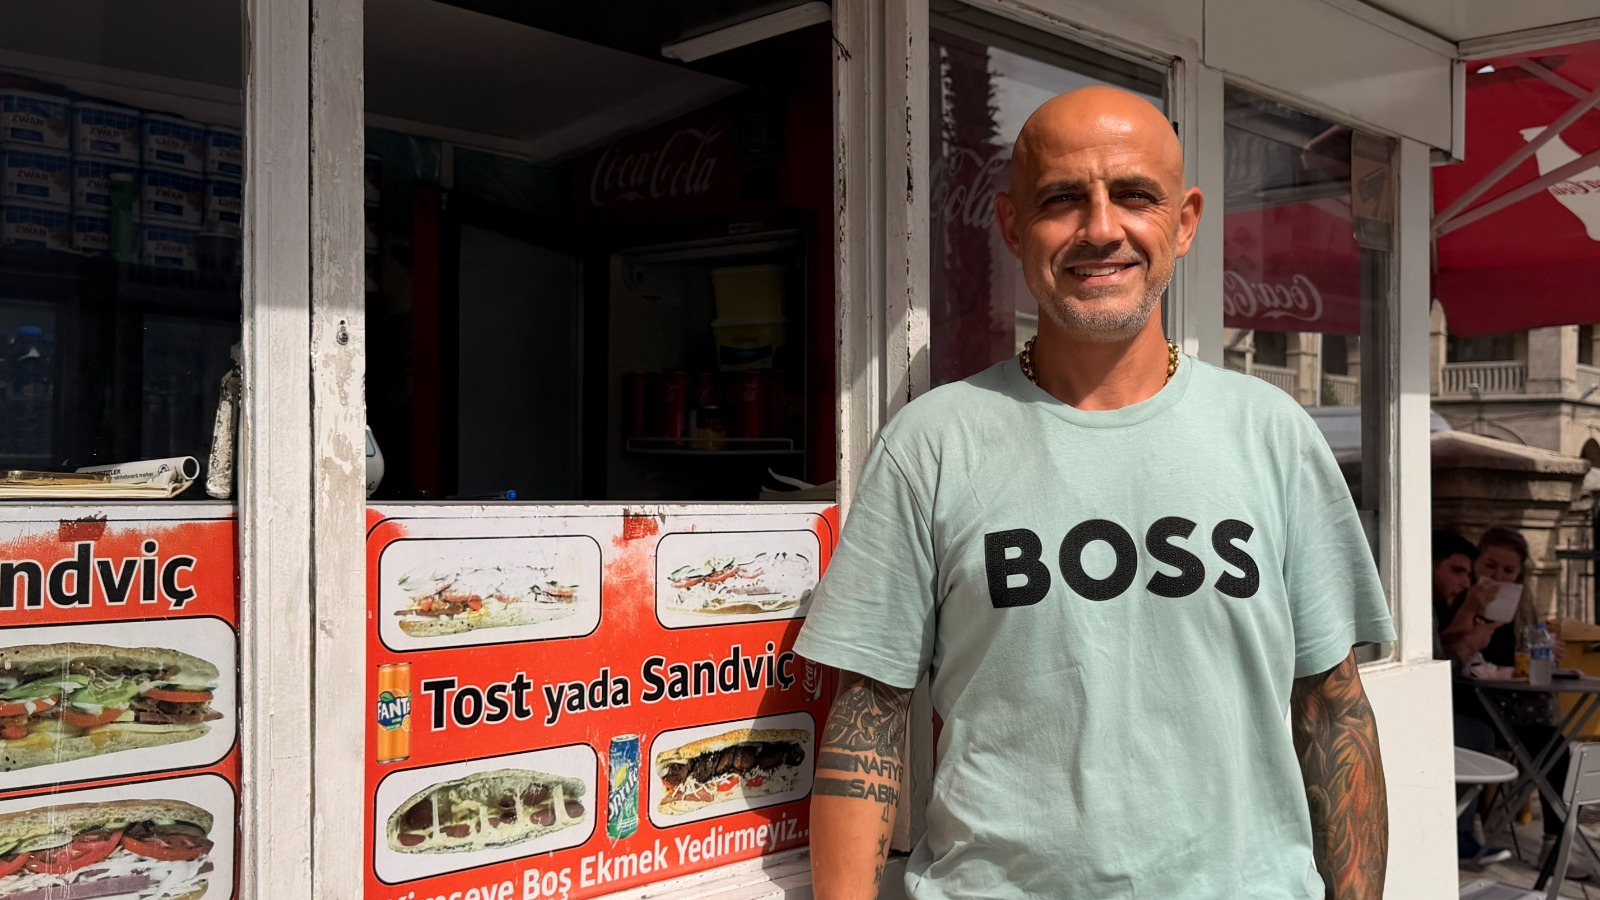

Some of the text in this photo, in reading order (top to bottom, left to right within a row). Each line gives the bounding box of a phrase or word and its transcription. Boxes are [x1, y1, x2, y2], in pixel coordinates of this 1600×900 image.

[12, 113, 44, 127] ZWAN
[91, 126, 121, 139] ZWAN
[17, 169, 49, 182] ZWAN
[590, 124, 723, 207] Coca-Cola
[86, 178, 112, 191] ZWA
[83, 233, 110, 245] ZWA
[138, 471, 154, 480] marker
[984, 516, 1260, 609] BOSS
[0, 540, 197, 609] ndviç
[422, 642, 795, 732] Tost yada Sandviç
[849, 778, 900, 808] SABIH
[523, 868, 572, 899] Boş
[580, 838, 668, 889] Ekmek
